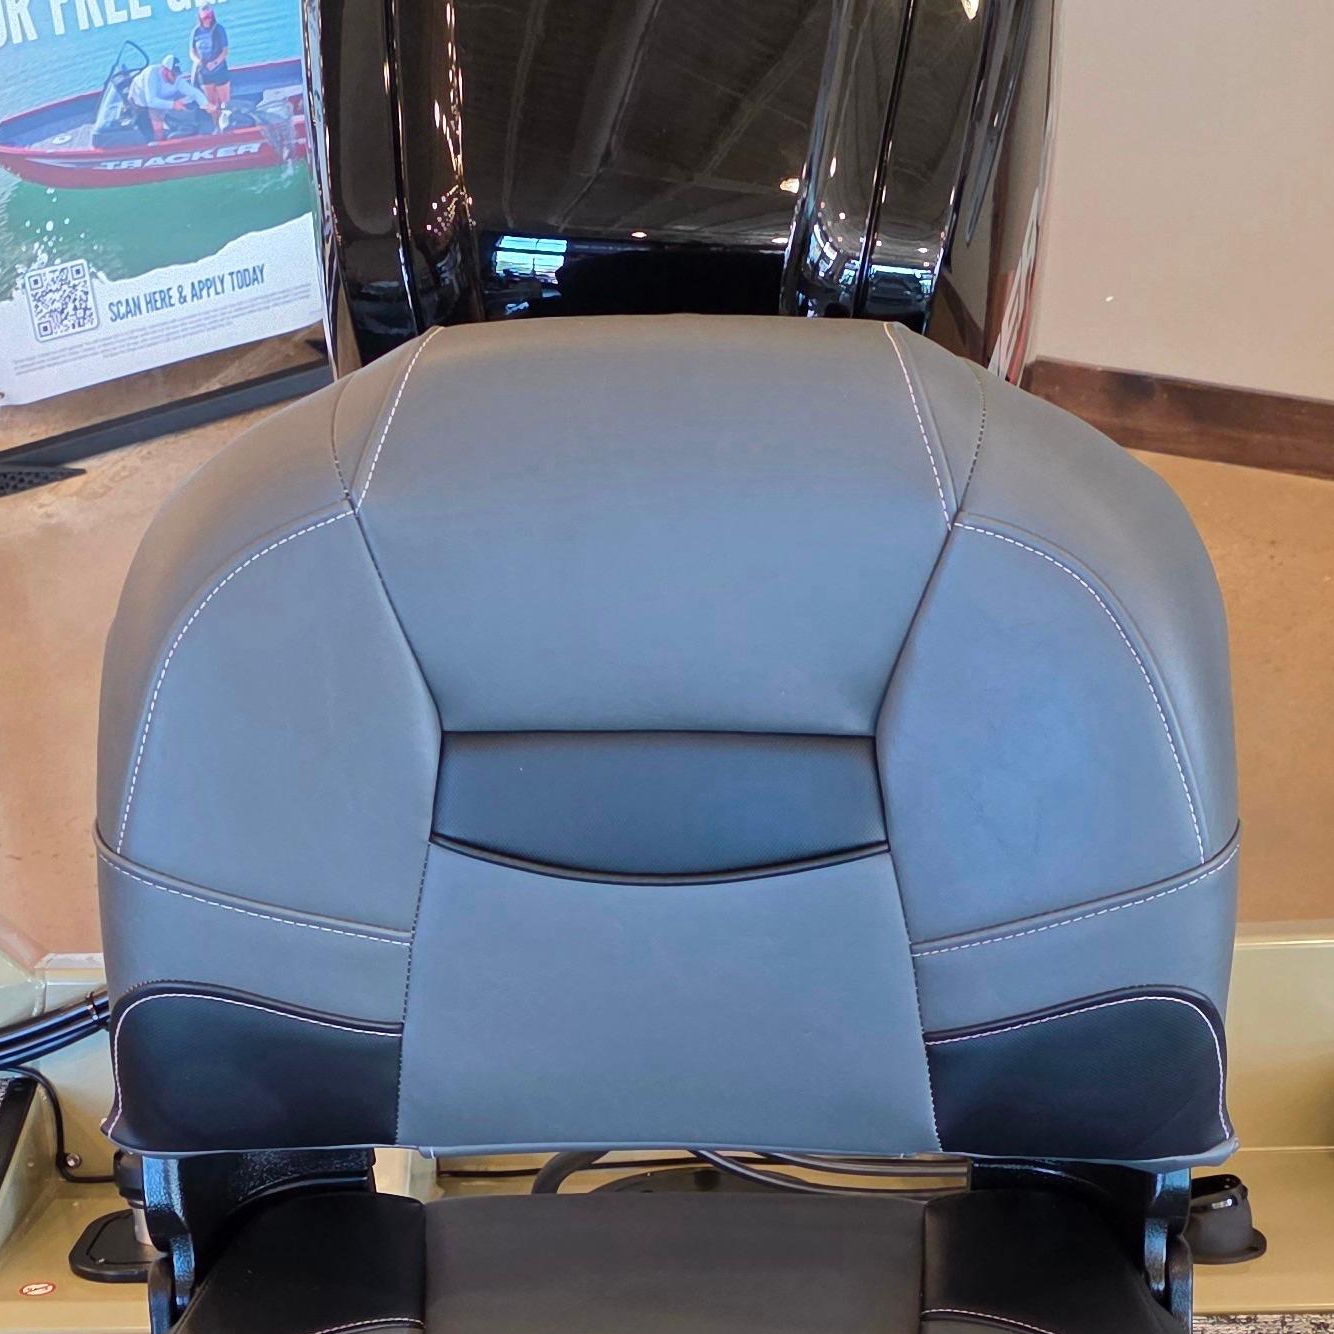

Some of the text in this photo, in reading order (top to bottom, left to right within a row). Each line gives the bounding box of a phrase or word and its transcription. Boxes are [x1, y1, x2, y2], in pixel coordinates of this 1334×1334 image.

[100, 142, 262, 170] TRACKER
[108, 263, 265, 323] SCAN HERE & APPLY TODAY
